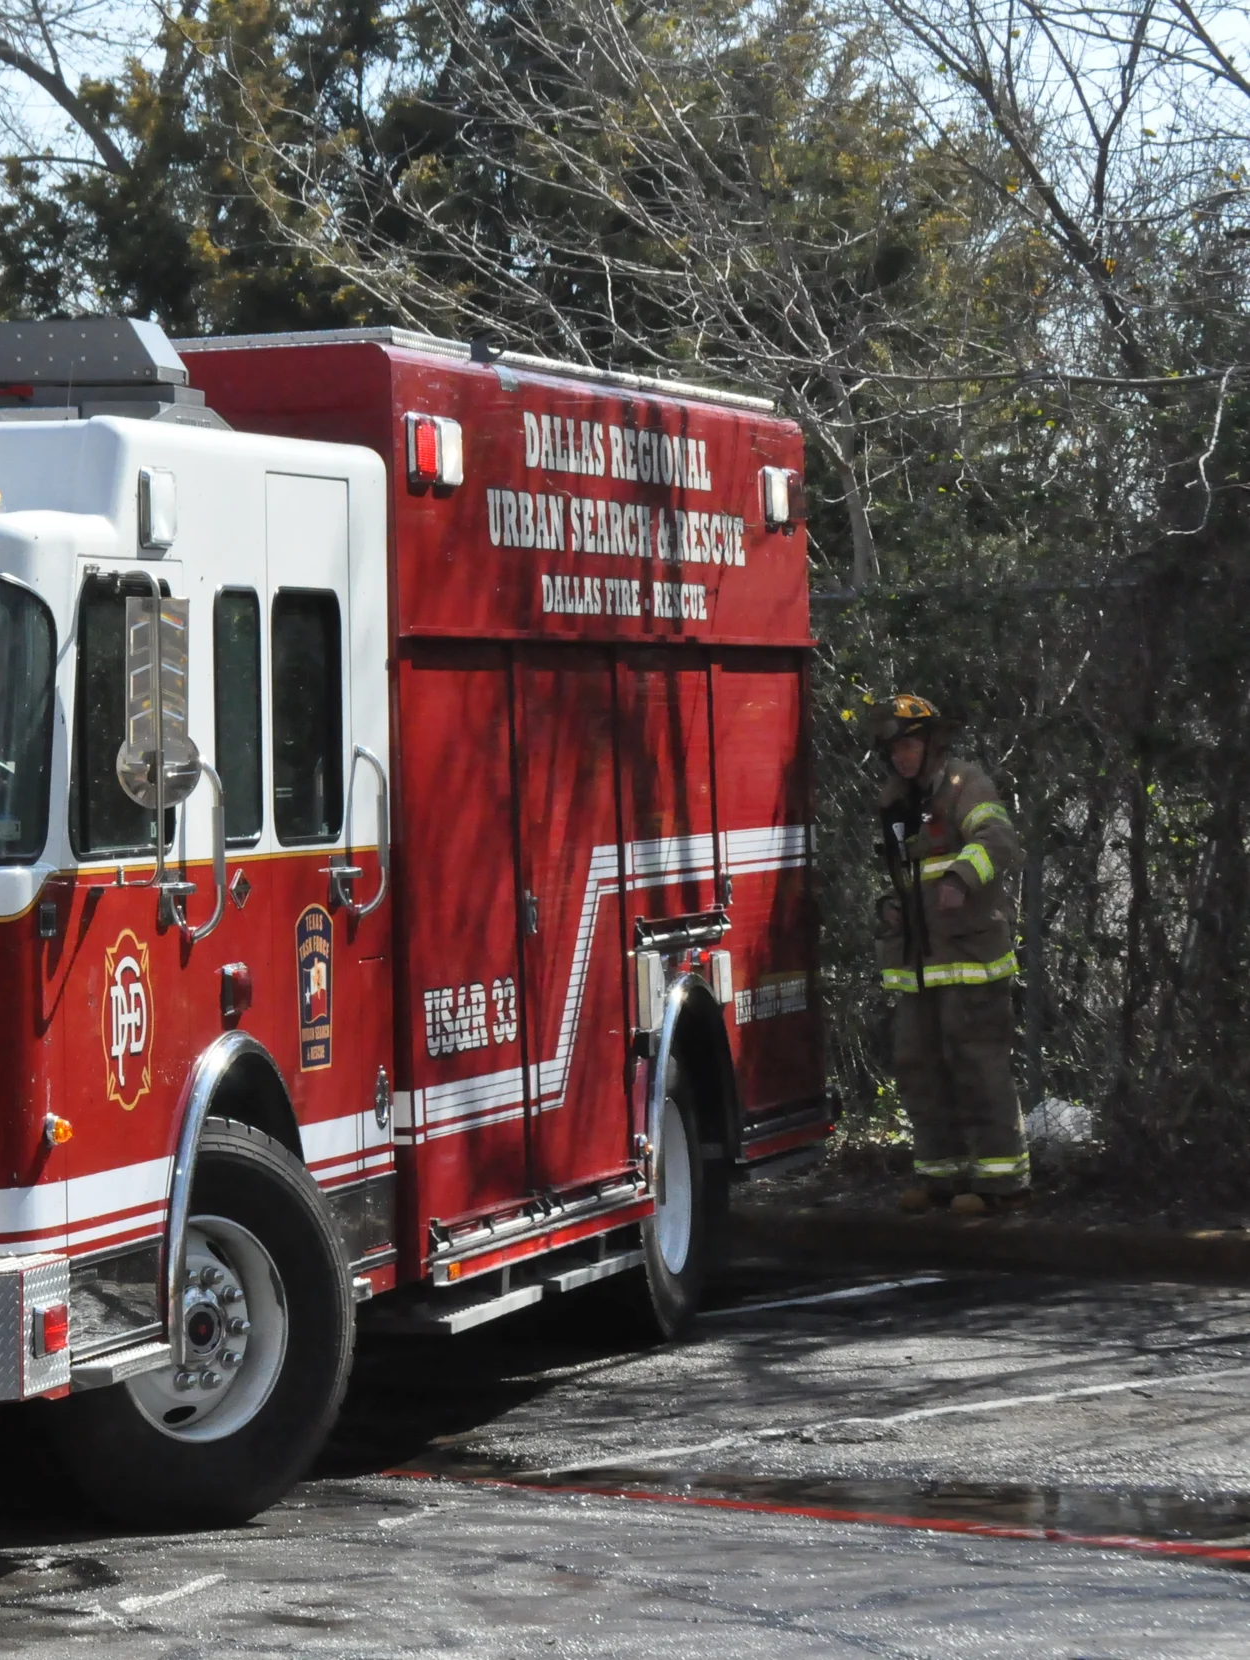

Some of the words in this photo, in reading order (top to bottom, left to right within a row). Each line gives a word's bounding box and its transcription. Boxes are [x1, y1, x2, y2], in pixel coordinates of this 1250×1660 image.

[523, 411, 605, 477] DALLAS
[609, 425, 712, 492] REGIONAL
[486, 487, 565, 551] URBAN
[570, 495, 652, 559] SEARCH
[657, 507, 671, 561] &
[675, 509, 746, 567] RESCUE
[541, 574, 602, 614] DALLAS
[604, 577, 641, 617] FIRE
[653, 581, 708, 621] RESCUE
[305, 913, 323, 932] TEXAS
[424, 983, 488, 1057] US&R
[492, 977, 517, 1044] 33
